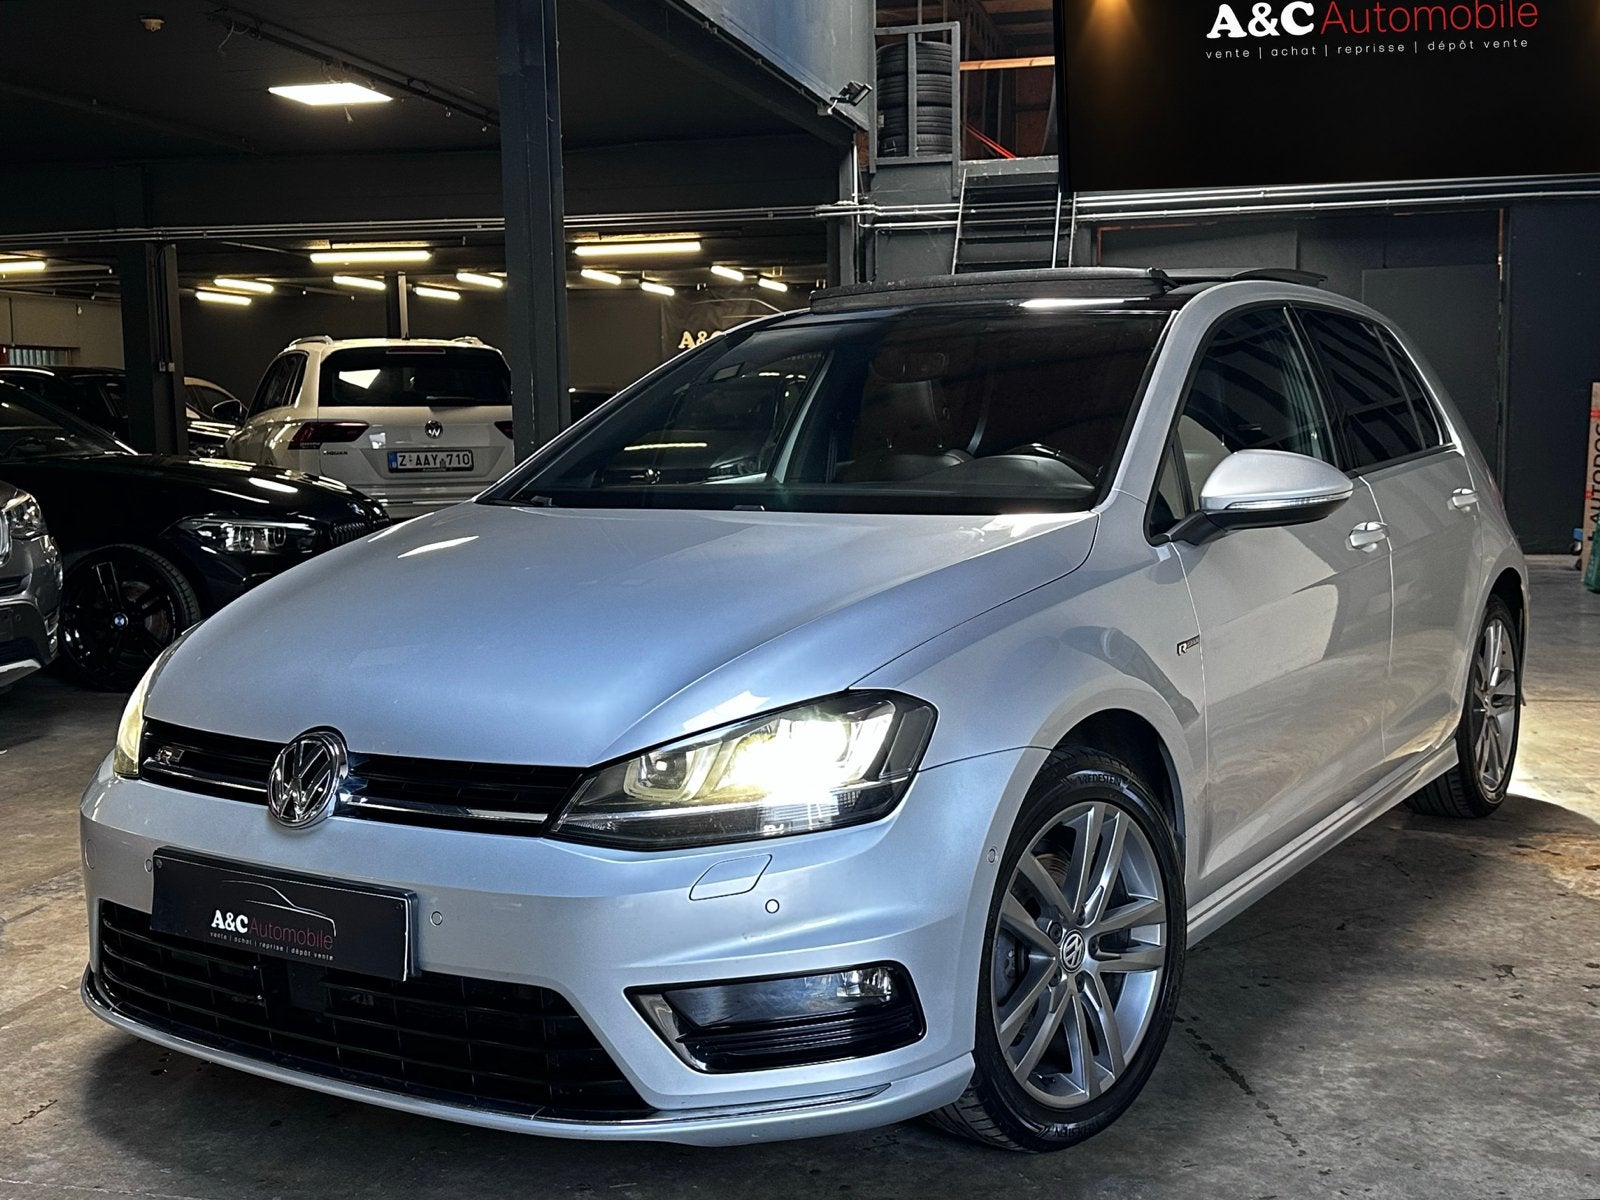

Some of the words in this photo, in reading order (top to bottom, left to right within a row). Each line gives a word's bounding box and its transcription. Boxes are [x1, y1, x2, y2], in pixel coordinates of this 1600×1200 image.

[1206, 1, 1315, 39] A&C
[1320, 0, 1538, 34] Automobile
[1205, 49, 1250, 59] vente
[1271, 46, 1316, 56] achat
[1337, 43, 1405, 56] reprisse
[1427, 40, 1474, 52] dépôt
[1483, 38, 1528, 49] vente
[678, 330, 723, 349] A&
[211, 909, 249, 934] A&C
[250, 917, 333, 950] Automobile
